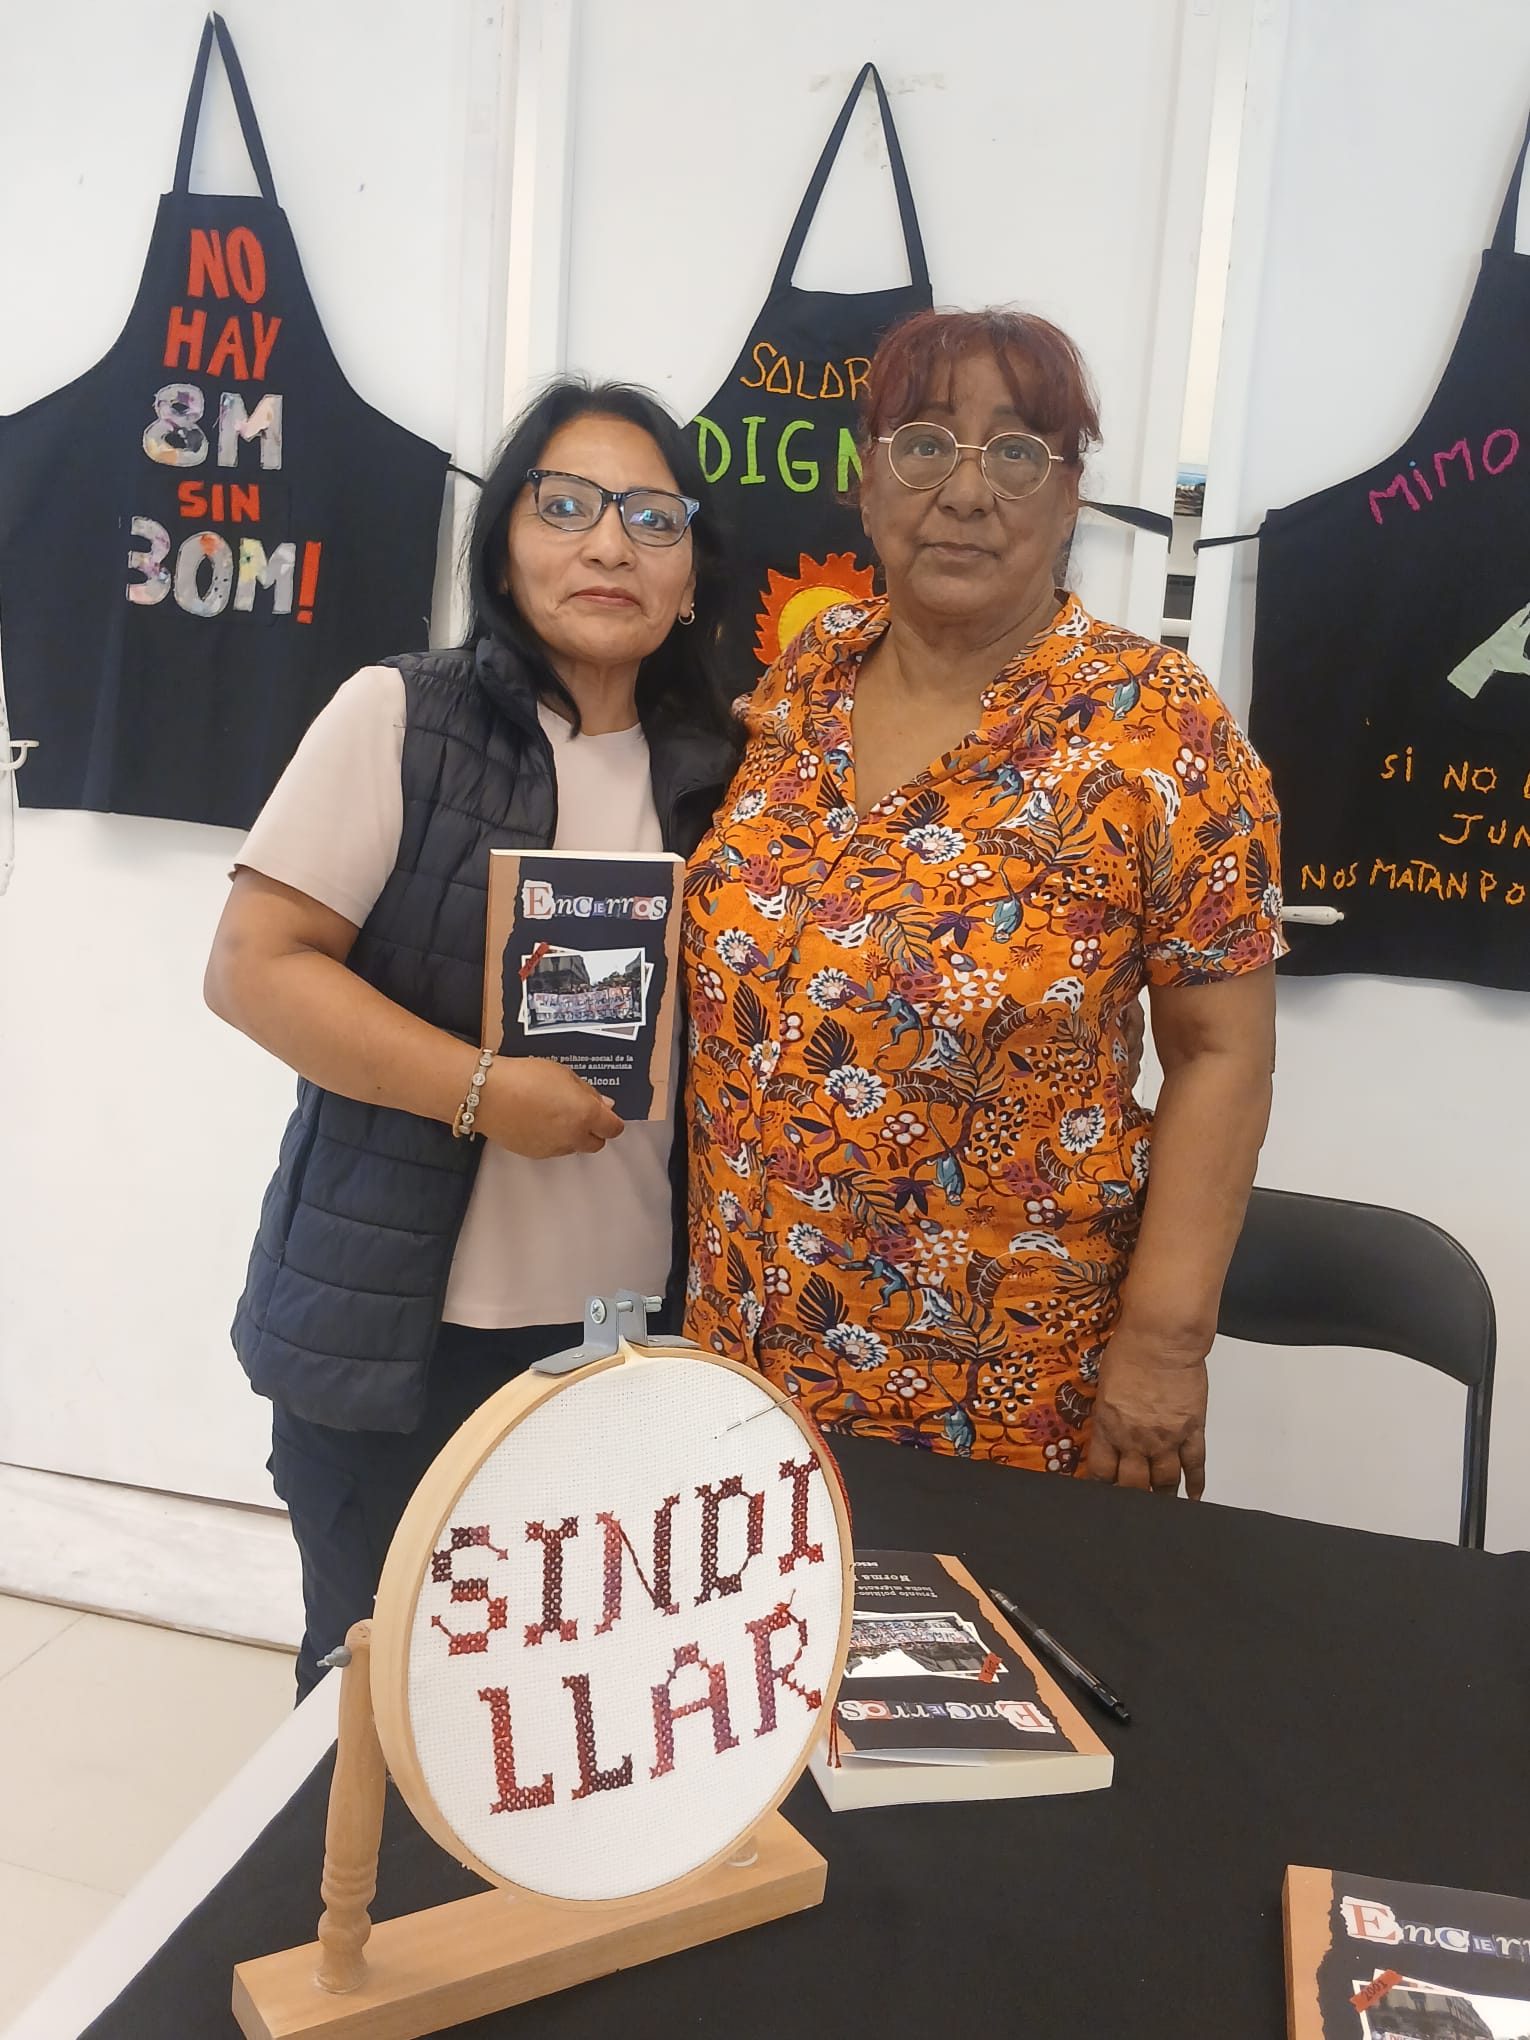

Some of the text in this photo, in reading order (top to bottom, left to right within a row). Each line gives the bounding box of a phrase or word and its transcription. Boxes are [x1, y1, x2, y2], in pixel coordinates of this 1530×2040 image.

[188, 226, 267, 304] NO
[163, 306, 282, 381] HAY
[142, 383, 283, 471] 8M
[177, 480, 261, 523] SIN
[125, 515, 322, 625] 30M!
[1443, 761, 1498, 794] NO
[1300, 861, 1359, 890] NOS
[1369, 857, 1468, 900] MATAN
[431, 1451, 825, 1656] SINDI
[860, 1574, 912, 1582] Norma
[477, 1602, 823, 1815] LLAR
